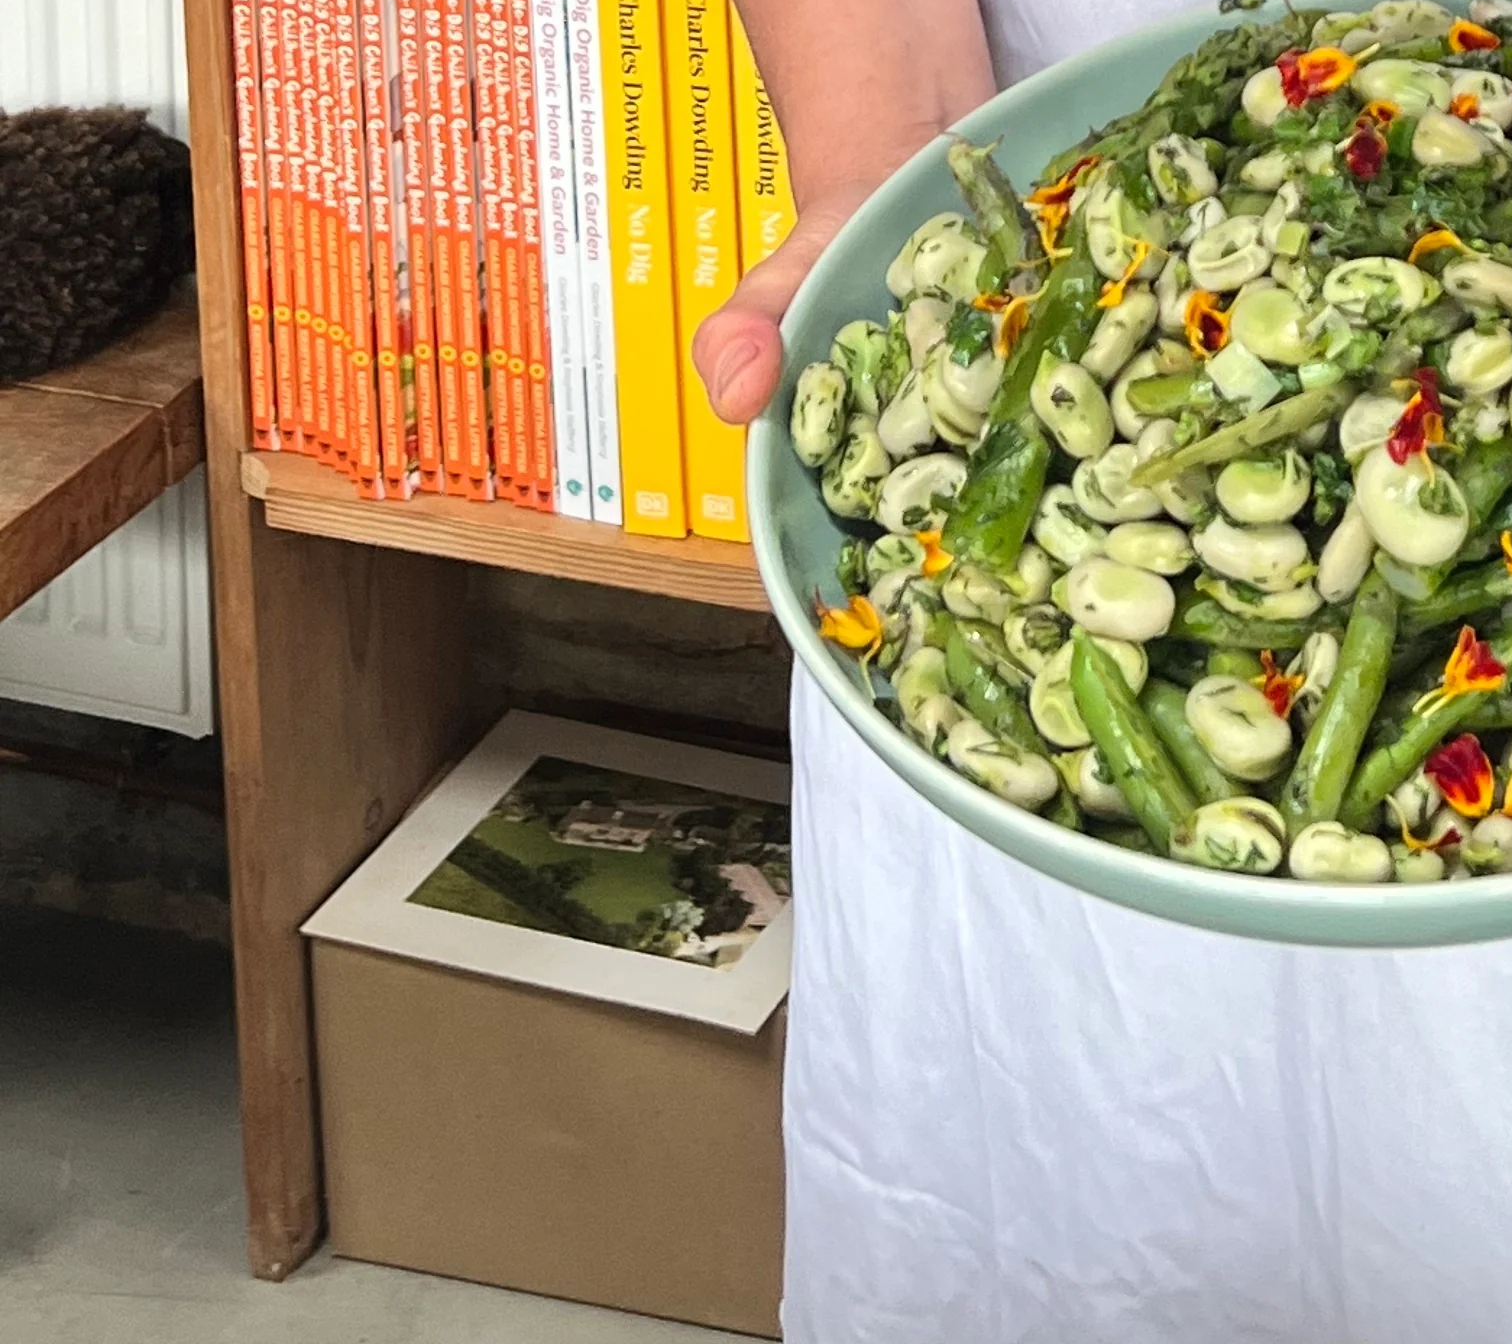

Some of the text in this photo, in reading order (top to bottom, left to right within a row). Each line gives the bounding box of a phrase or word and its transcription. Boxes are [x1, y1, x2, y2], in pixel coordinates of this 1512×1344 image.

[539, 24, 561, 98] Organic
[573, 29, 596, 103] Organic
[547, 104, 565, 161] Home
[581, 110, 595, 167] Home
[623, 82, 648, 190] Dowding
[690, 84, 713, 193] Dowding
[550, 166, 565, 180] &
[583, 172, 599, 186] &
[551, 186, 568, 256] Garden
[585, 192, 601, 261] Garden
[627, 204, 651, 240] No
[695, 207, 717, 244] No
[626, 245, 653, 285] Dig
[694, 249, 720, 288] Dig
